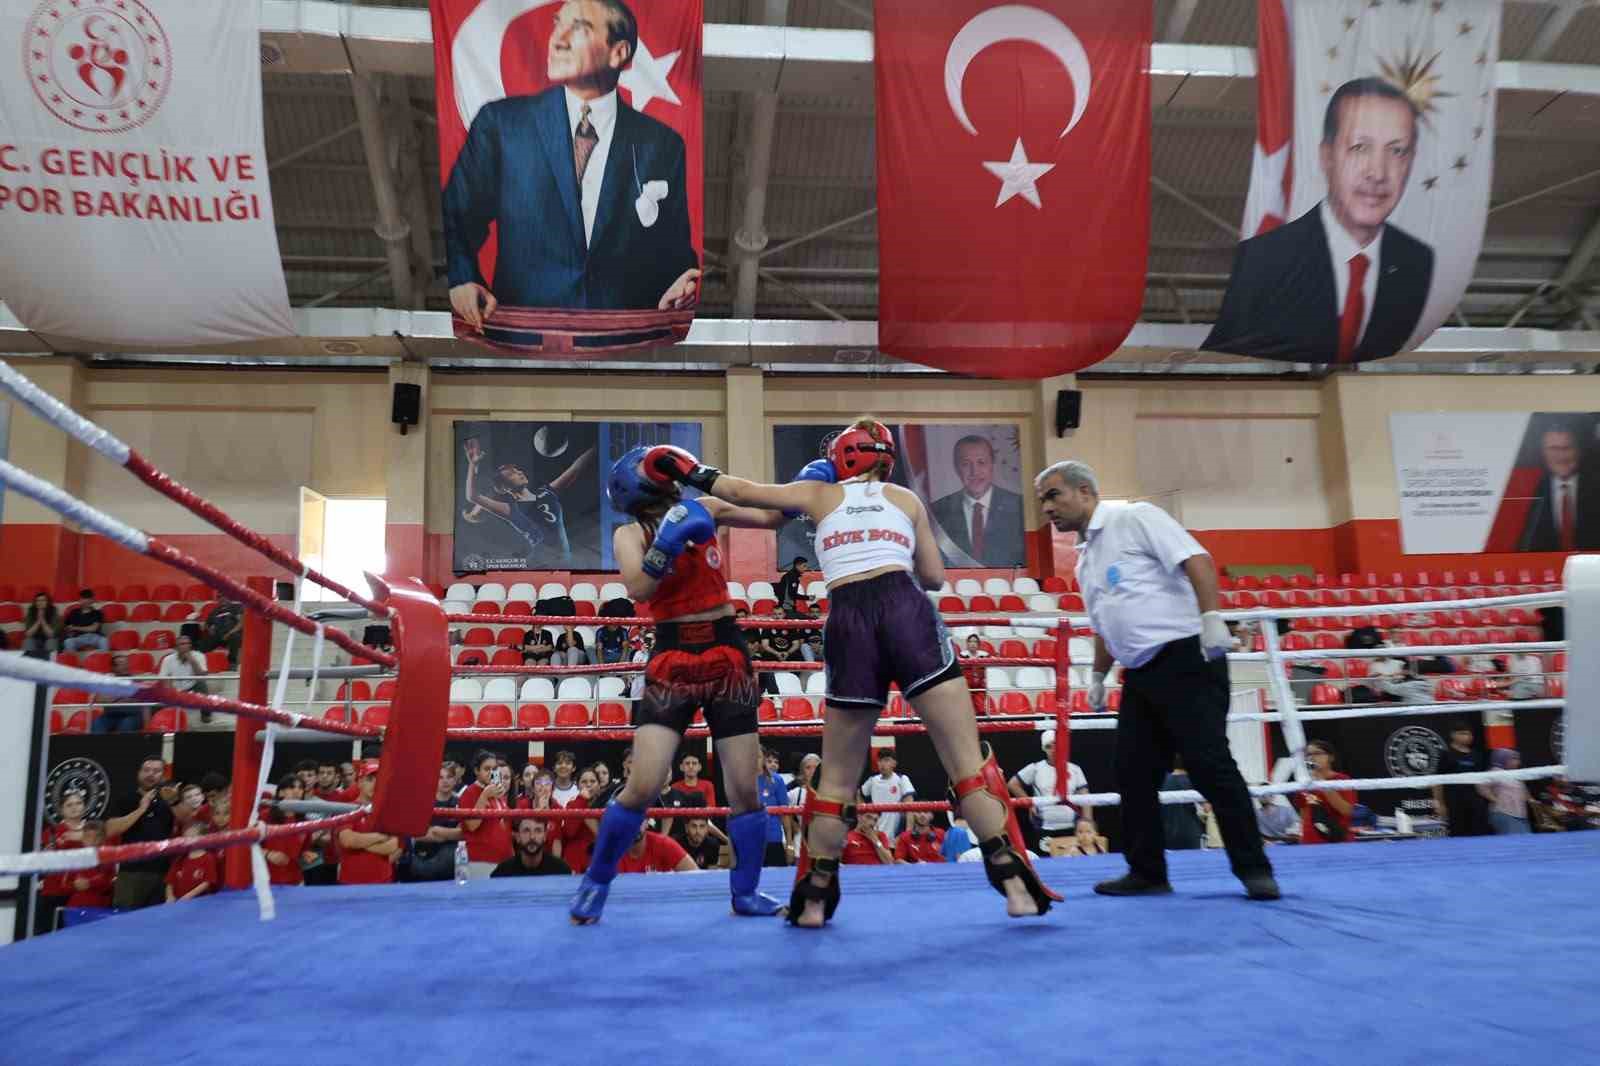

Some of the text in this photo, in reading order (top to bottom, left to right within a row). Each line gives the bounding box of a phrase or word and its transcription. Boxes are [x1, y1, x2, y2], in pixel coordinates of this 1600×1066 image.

[0, 145, 256, 187] C. GENÇLİK VE
[72, 189, 261, 223] BAKANLIĞI
[537, 503, 557, 524] 3
